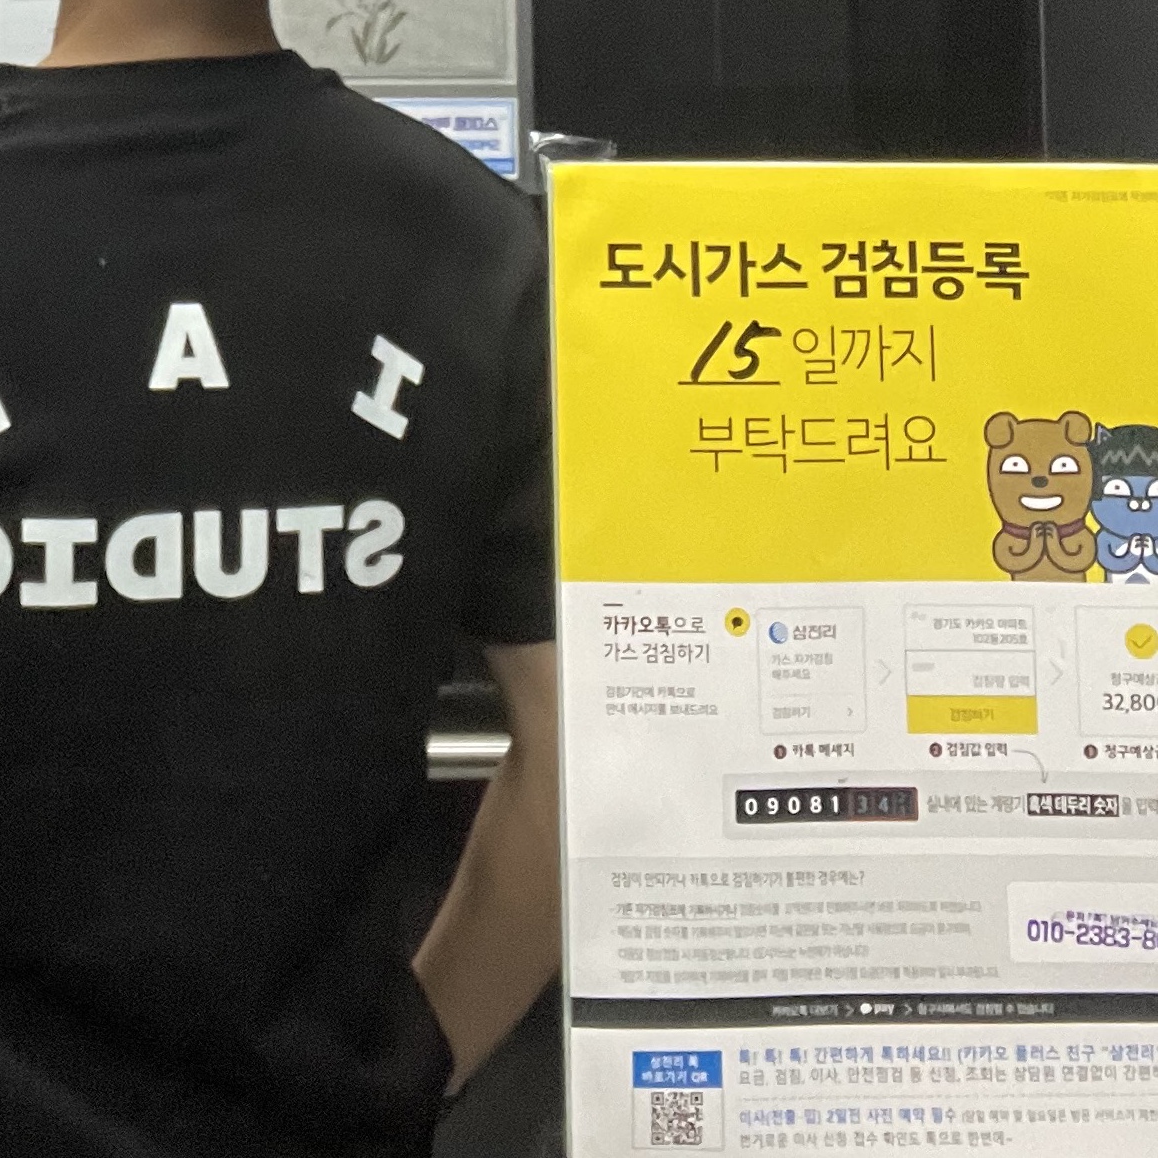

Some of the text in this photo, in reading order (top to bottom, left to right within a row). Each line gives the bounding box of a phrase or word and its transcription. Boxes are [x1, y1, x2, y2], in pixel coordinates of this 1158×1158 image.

[599, 239, 1030, 300] 도시가스 검침등록
[689, 319, 782, 383] 15
[792, 324, 938, 385] 일까지
[689, 414, 948, 473] 부탁드려요
[603, 615, 706, 636] 카카오톡으로
[604, 643, 711, 664] 가스 검침하기
[1111, 671, 1158, 686] 청구예상
[1102, 692, 1158, 714] 32,80
[1027, 919, 1158, 950] 010-2383-8
